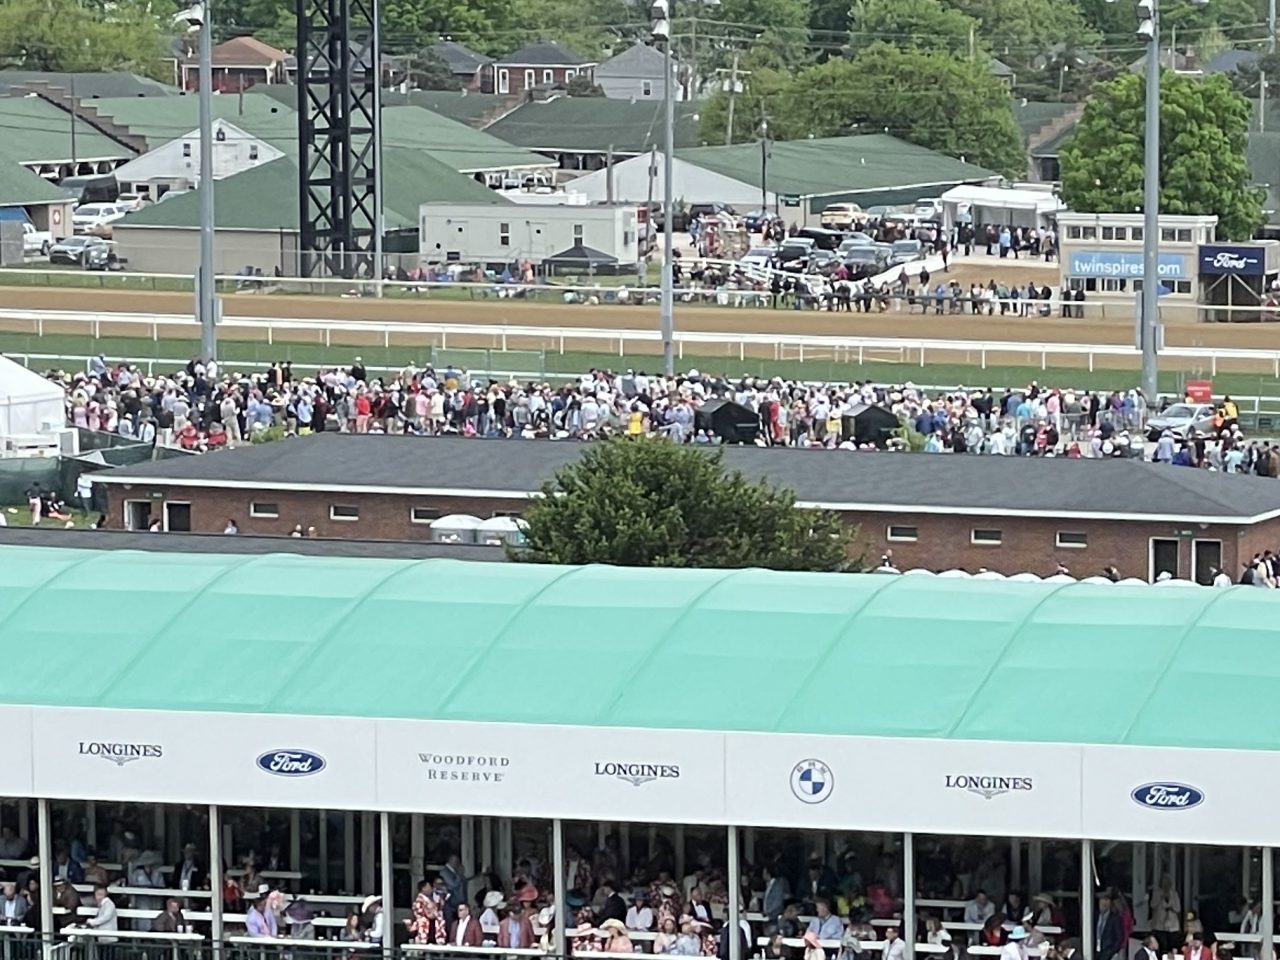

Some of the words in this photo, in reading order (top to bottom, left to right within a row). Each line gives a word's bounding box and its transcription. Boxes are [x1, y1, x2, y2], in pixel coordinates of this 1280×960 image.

[1074, 255, 1181, 275] twinspiresom
[1213, 252, 1248, 269] Ford
[79, 742, 163, 758] LONGINES
[269, 752, 313, 772] Ford
[418, 752, 510, 767] WOODFORD
[428, 769, 504, 782] RESERVE
[594, 763, 680, 778] LONGINES
[945, 775, 1032, 790] LONGINES
[1145, 785, 1191, 806] Ford
